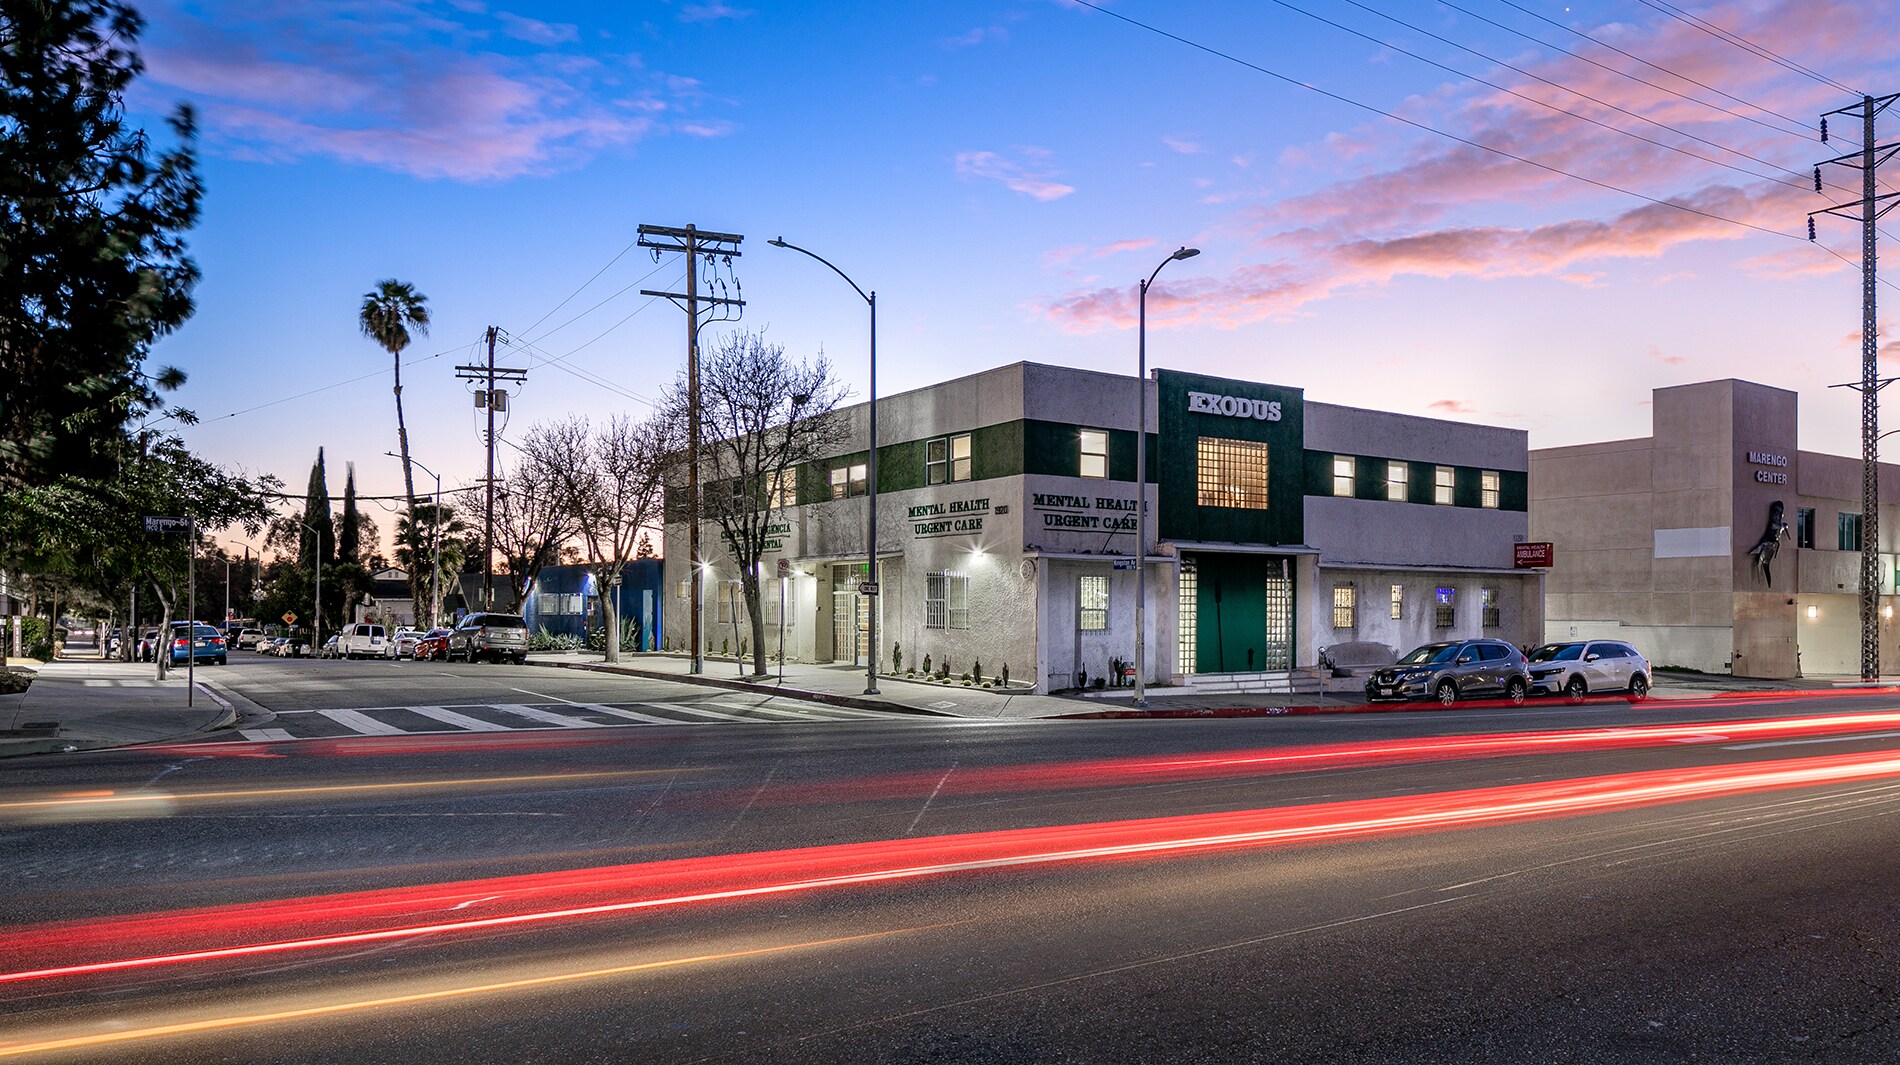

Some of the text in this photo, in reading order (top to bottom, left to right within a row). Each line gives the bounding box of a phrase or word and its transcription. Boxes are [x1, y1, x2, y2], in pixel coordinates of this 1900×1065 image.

[1188, 391, 1281, 421] EXODUS
[1749, 451, 1788, 467] MARENGO
[1757, 470, 1788, 484] CENTER
[908, 498, 990, 517] MENTAL HEALTH
[1033, 493, 1148, 512] MENTAL HEALT
[145, 517, 188, 528] Marengo St
[915, 518, 983, 534] URGENT CARE
[1043, 513, 1138, 530] URGENT CARE
[1516, 549, 1545, 558] AMBULANCE
